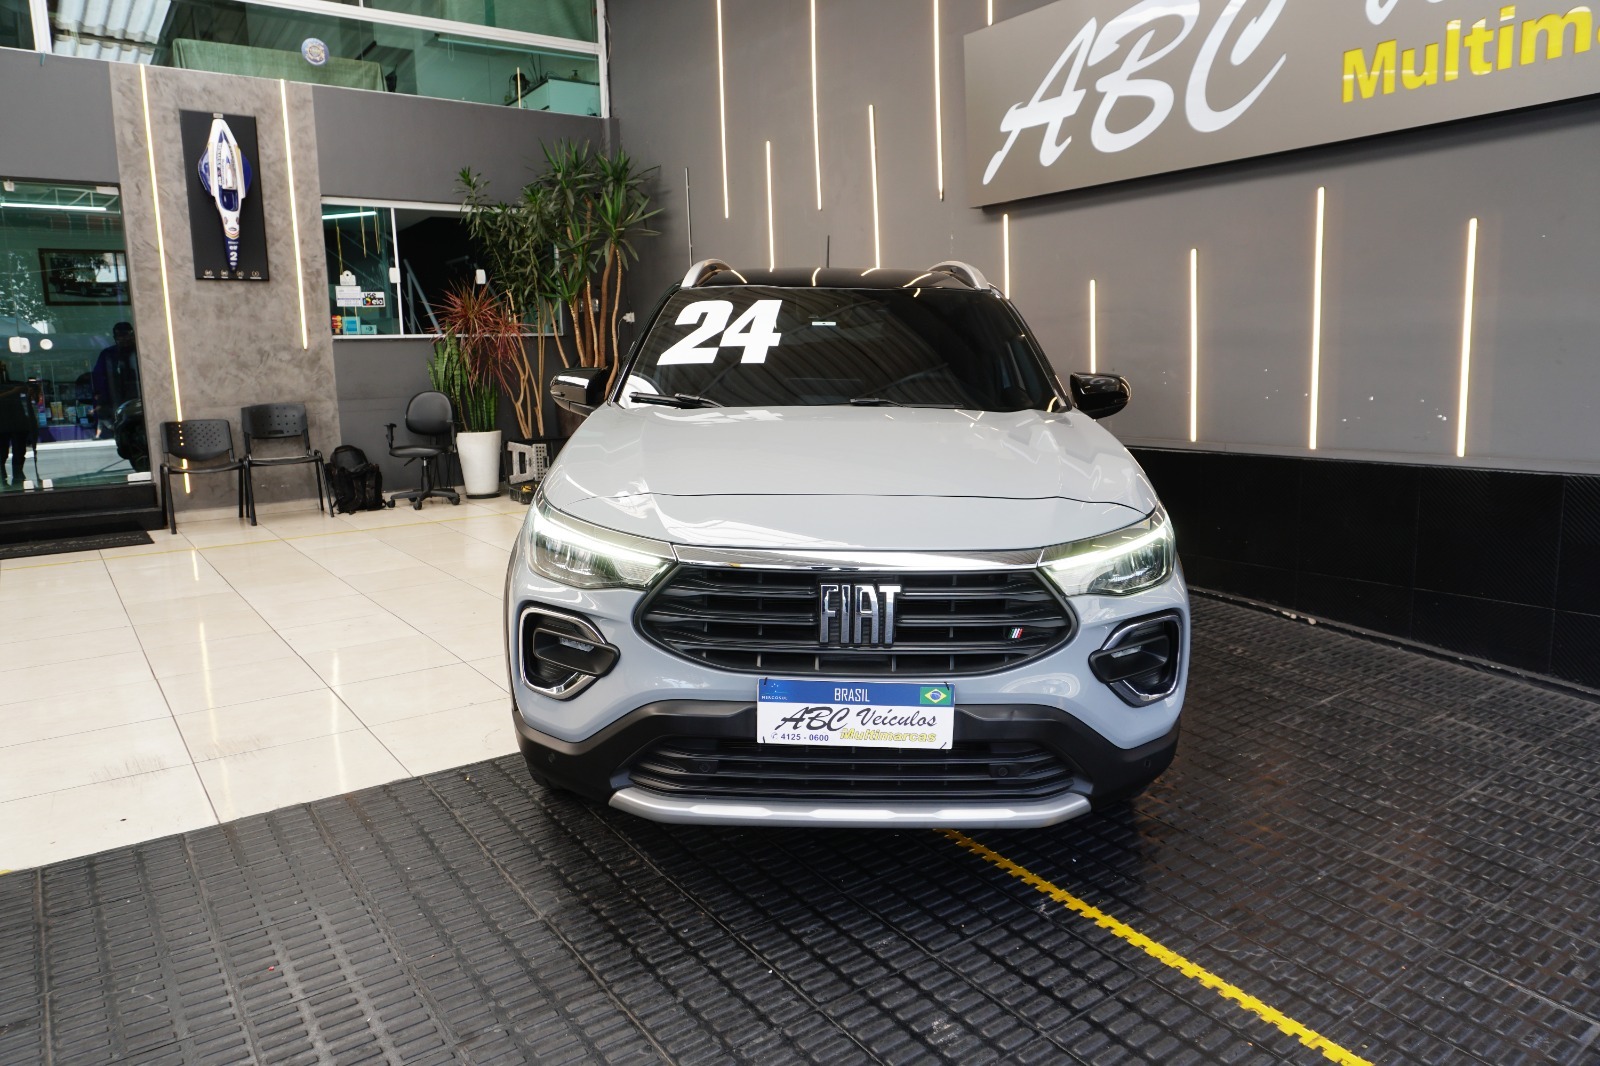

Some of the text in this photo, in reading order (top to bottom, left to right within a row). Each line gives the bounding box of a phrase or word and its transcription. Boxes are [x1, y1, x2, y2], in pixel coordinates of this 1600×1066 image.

[1342, 5, 1600, 104] Multim
[983, 0, 1286, 185] ABC
[656, 299, 783, 366] 24
[819, 583, 902, 644] FIAT
[834, 687, 870, 702] BRASIL
[774, 706, 938, 731] ABC Veículos
[780, 733, 801, 741] 4125
[808, 734, 829, 742] 0600
[840, 728, 937, 743] Multimarcas
